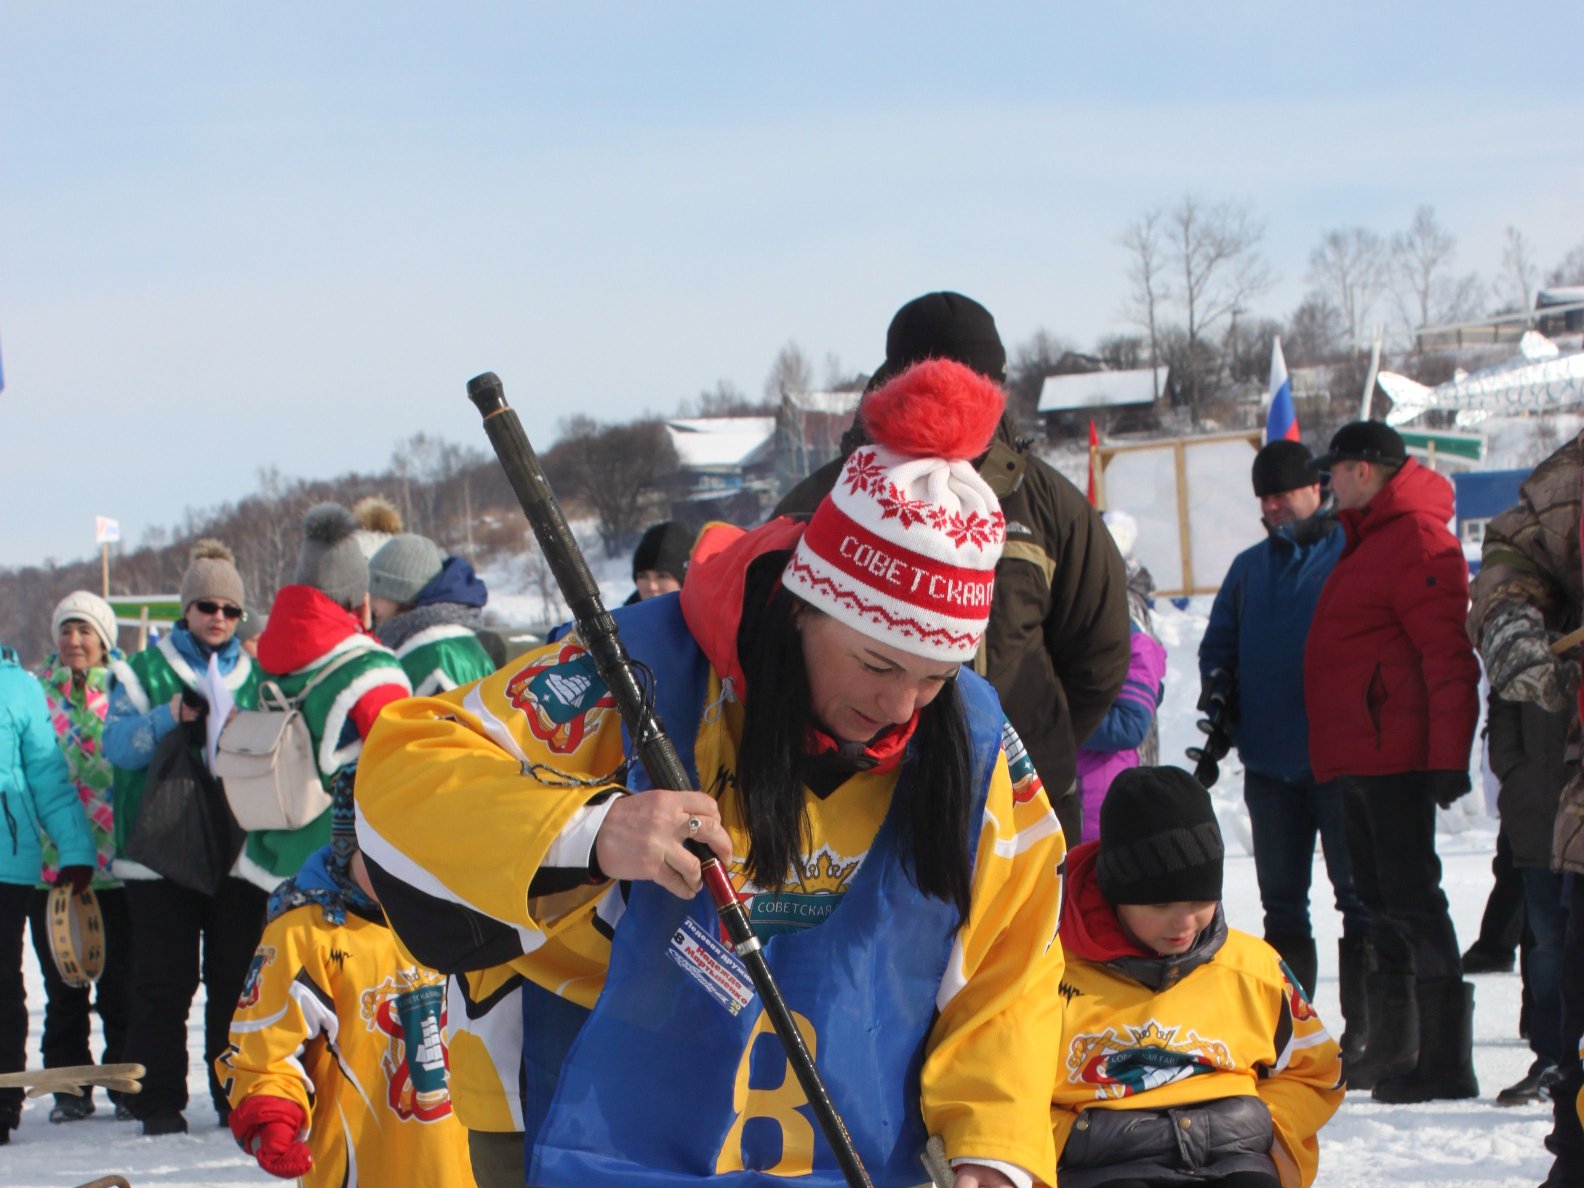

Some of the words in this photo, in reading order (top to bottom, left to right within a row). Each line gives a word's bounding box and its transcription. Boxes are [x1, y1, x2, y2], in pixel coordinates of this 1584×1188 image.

[839, 535, 985, 607] СОВЕТСКАЯ
[757, 901, 832, 917] СОВЕТСКАЯ
[673, 931, 685, 945] 8
[684, 919, 721, 955] Ледовая
[696, 946, 742, 989] Надежда
